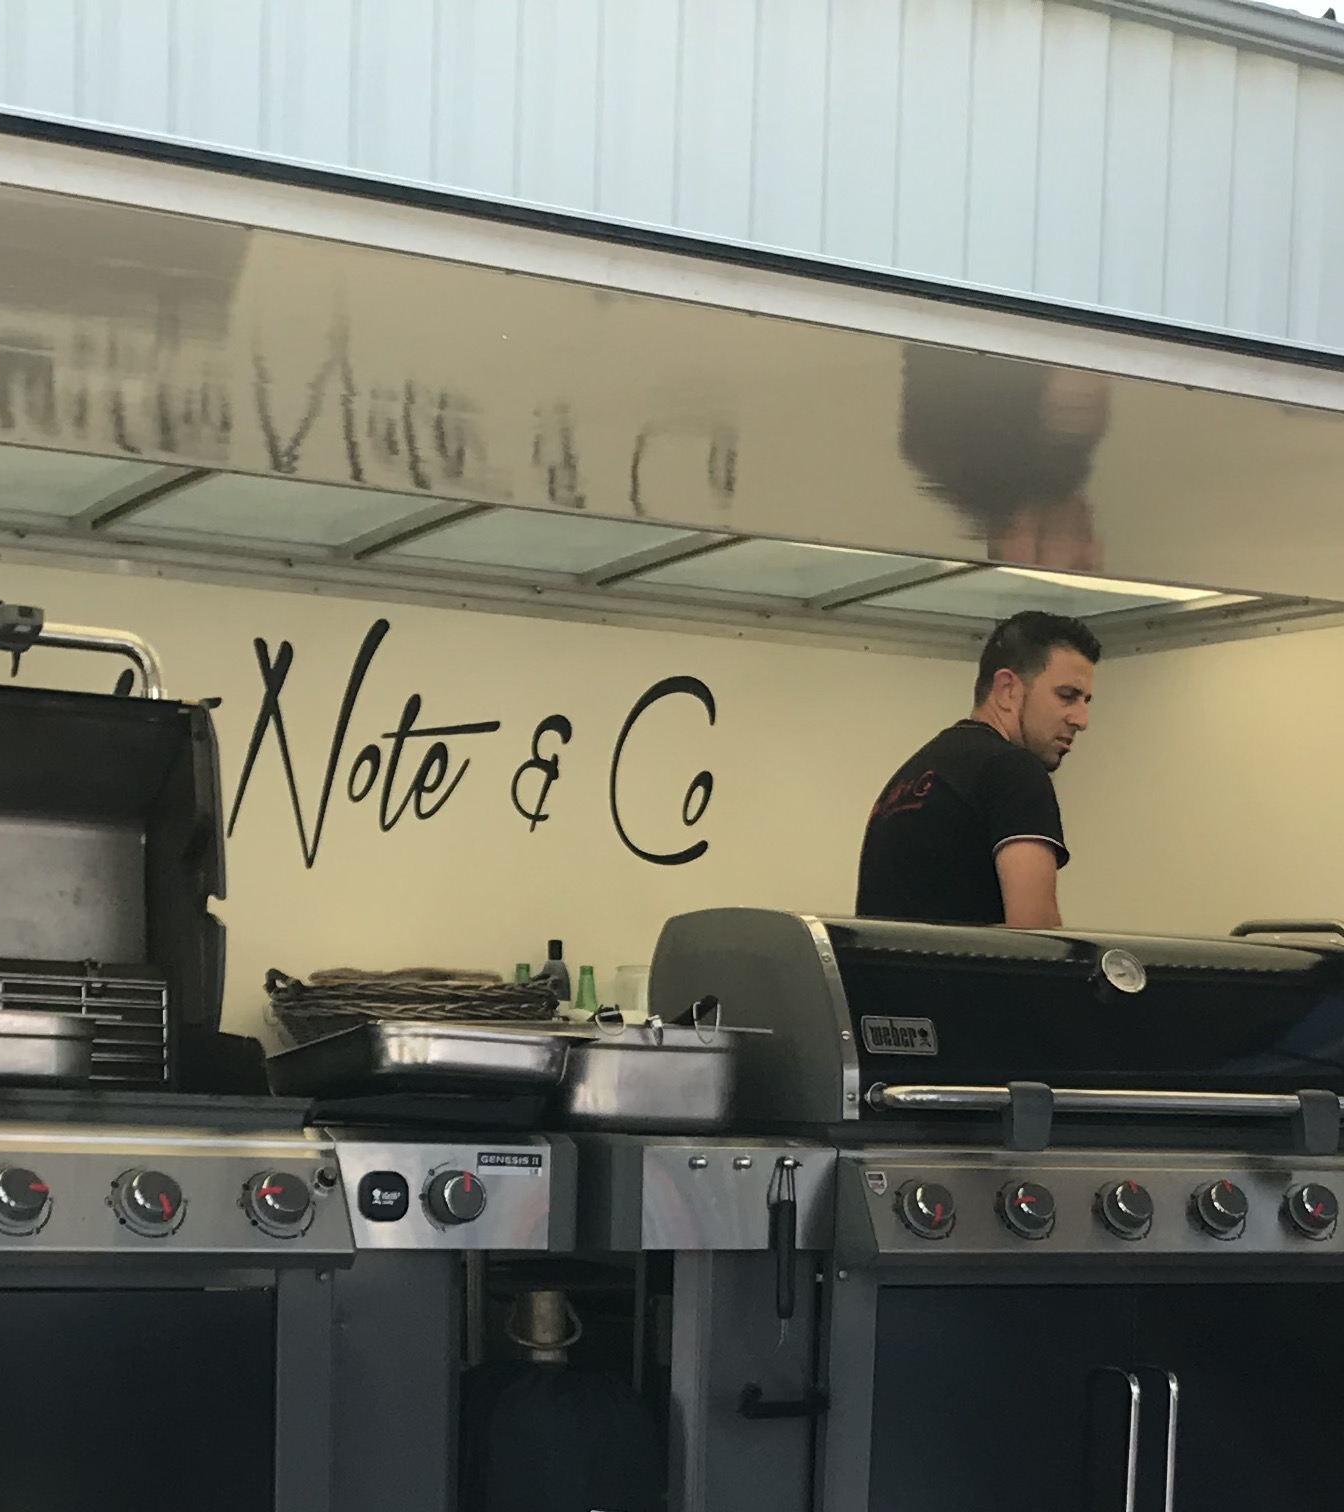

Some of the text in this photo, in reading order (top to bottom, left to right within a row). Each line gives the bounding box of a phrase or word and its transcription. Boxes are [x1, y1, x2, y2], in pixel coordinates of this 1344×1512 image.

[511, 714, 572, 832] &
[610, 675, 716, 865] Co
[869, 1019, 918, 1048] weber
[480, 1155, 529, 1169] GENESIS
